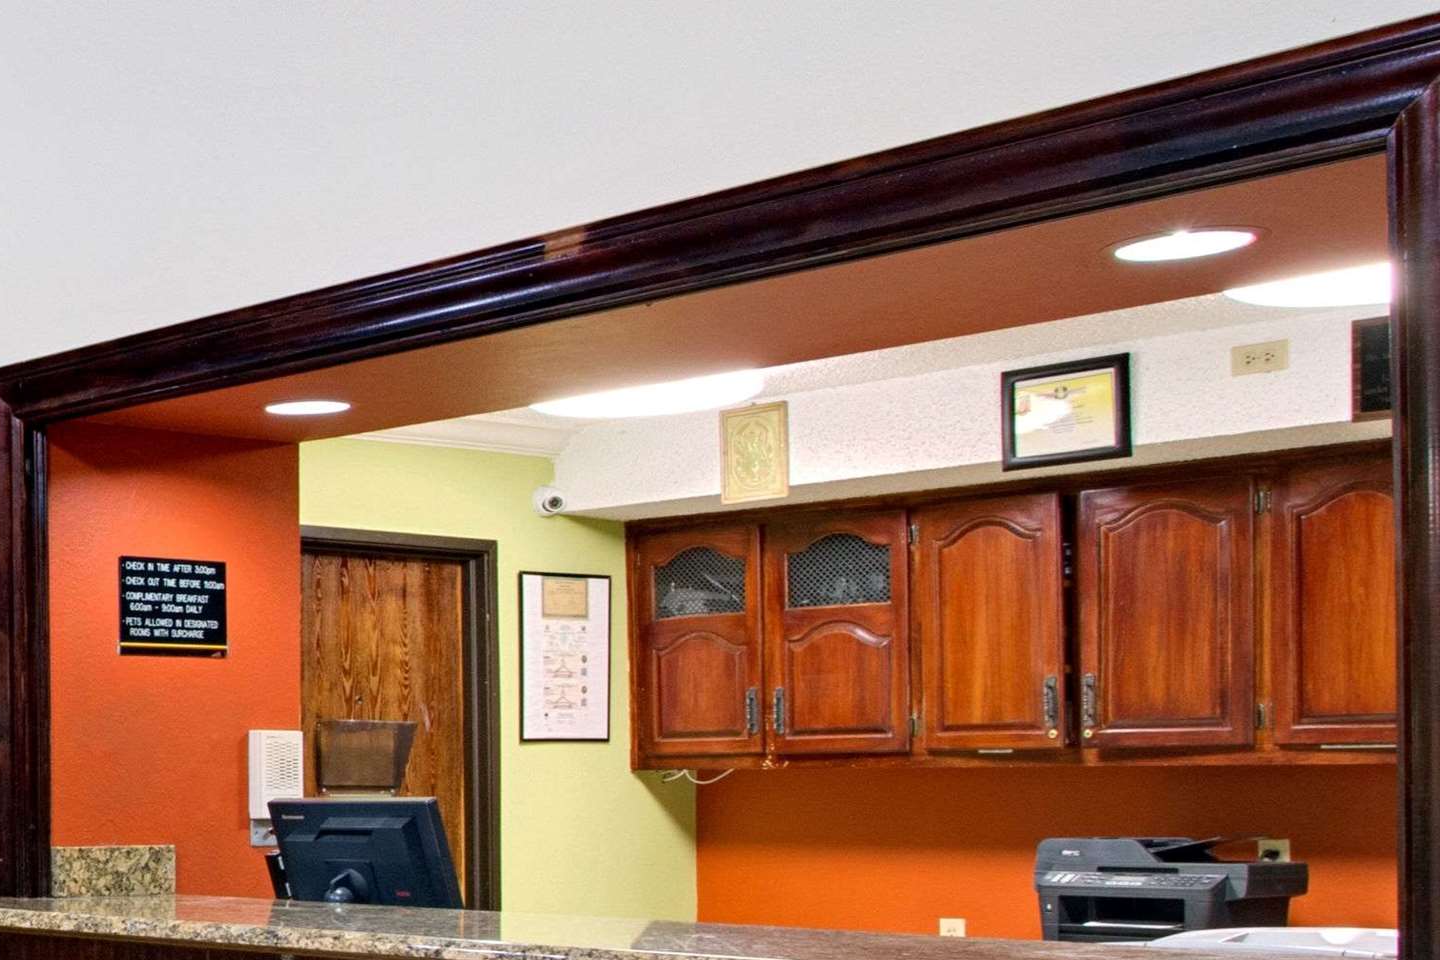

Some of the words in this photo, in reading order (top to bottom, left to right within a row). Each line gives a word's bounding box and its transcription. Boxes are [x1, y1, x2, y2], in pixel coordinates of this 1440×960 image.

[125, 561, 145, 570] CHECK
[147, 562, 154, 571] IN
[156, 563, 170, 572] TIME
[173, 564, 192, 574] AFTER
[125, 576, 145, 586] CHECK
[148, 577, 160, 586] OUT
[163, 578, 177, 588] TIME
[179, 578, 201, 588] BEFORE
[176, 593, 209, 604] BREAKFAST
[186, 604, 203, 614] DAILY
[125, 616, 142, 626] PETS
[144, 618, 173, 628] ALLOWED
[176, 619, 182, 628] IN
[184, 619, 219, 629] DESIGNATED
[129, 628, 151, 637] ROOMS
[153, 628, 169, 637] WITH
[170, 629, 204, 639] SURCHARGE
